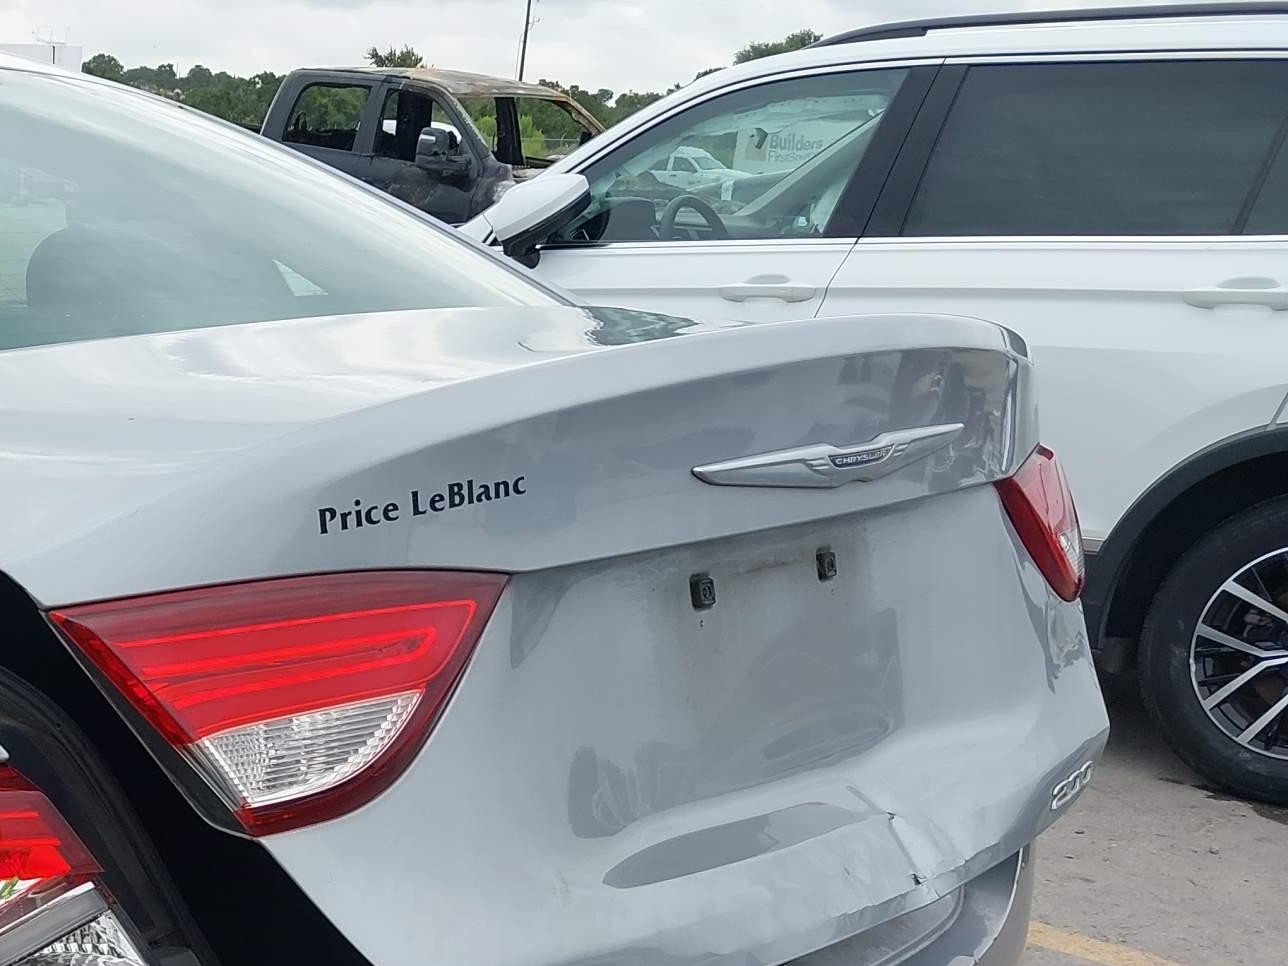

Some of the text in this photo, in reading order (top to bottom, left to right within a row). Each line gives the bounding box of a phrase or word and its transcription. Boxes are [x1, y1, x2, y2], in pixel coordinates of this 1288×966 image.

[769, 133, 823, 151] Builders
[835, 450, 887, 465] CHRYSLER
[318, 476, 527, 535] Price LeBlanc
